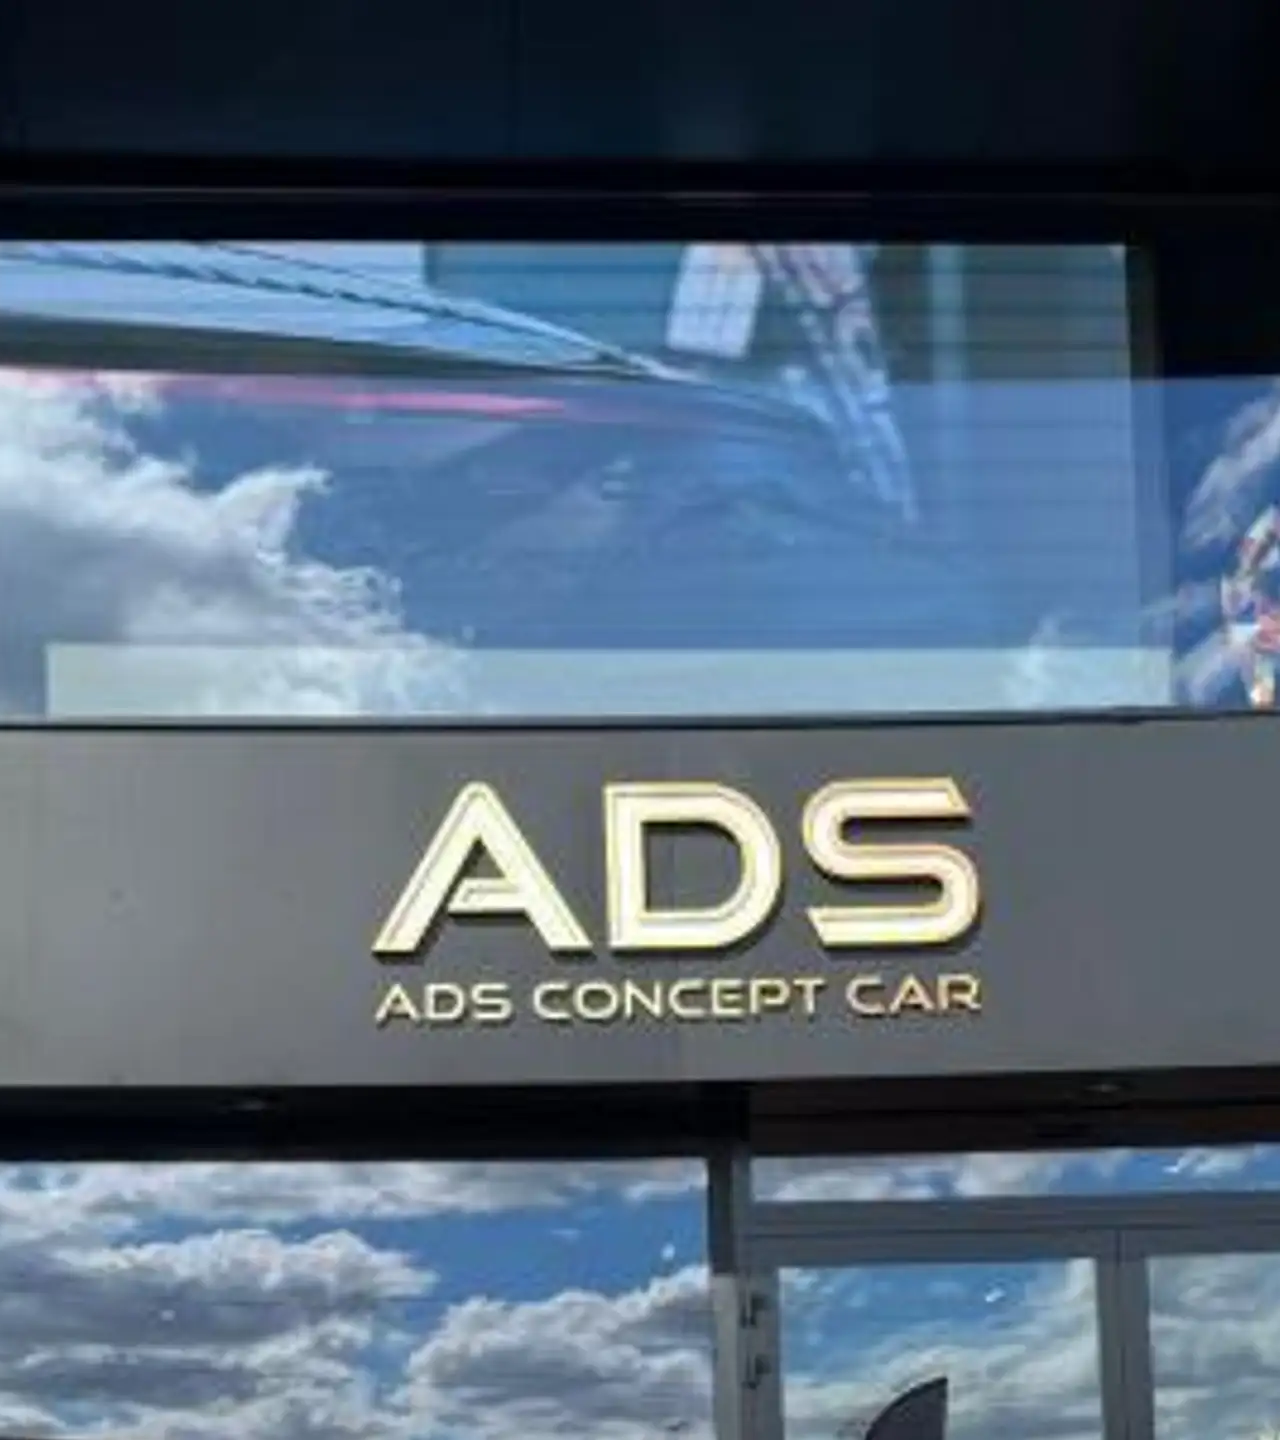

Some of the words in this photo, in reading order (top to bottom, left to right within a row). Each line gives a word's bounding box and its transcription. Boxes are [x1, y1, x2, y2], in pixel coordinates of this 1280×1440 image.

[372, 777, 981, 953] ADS
[375, 982, 512, 1022] ADS
[532, 978, 824, 1021] CONCEPT
[845, 974, 982, 1015] CAR
